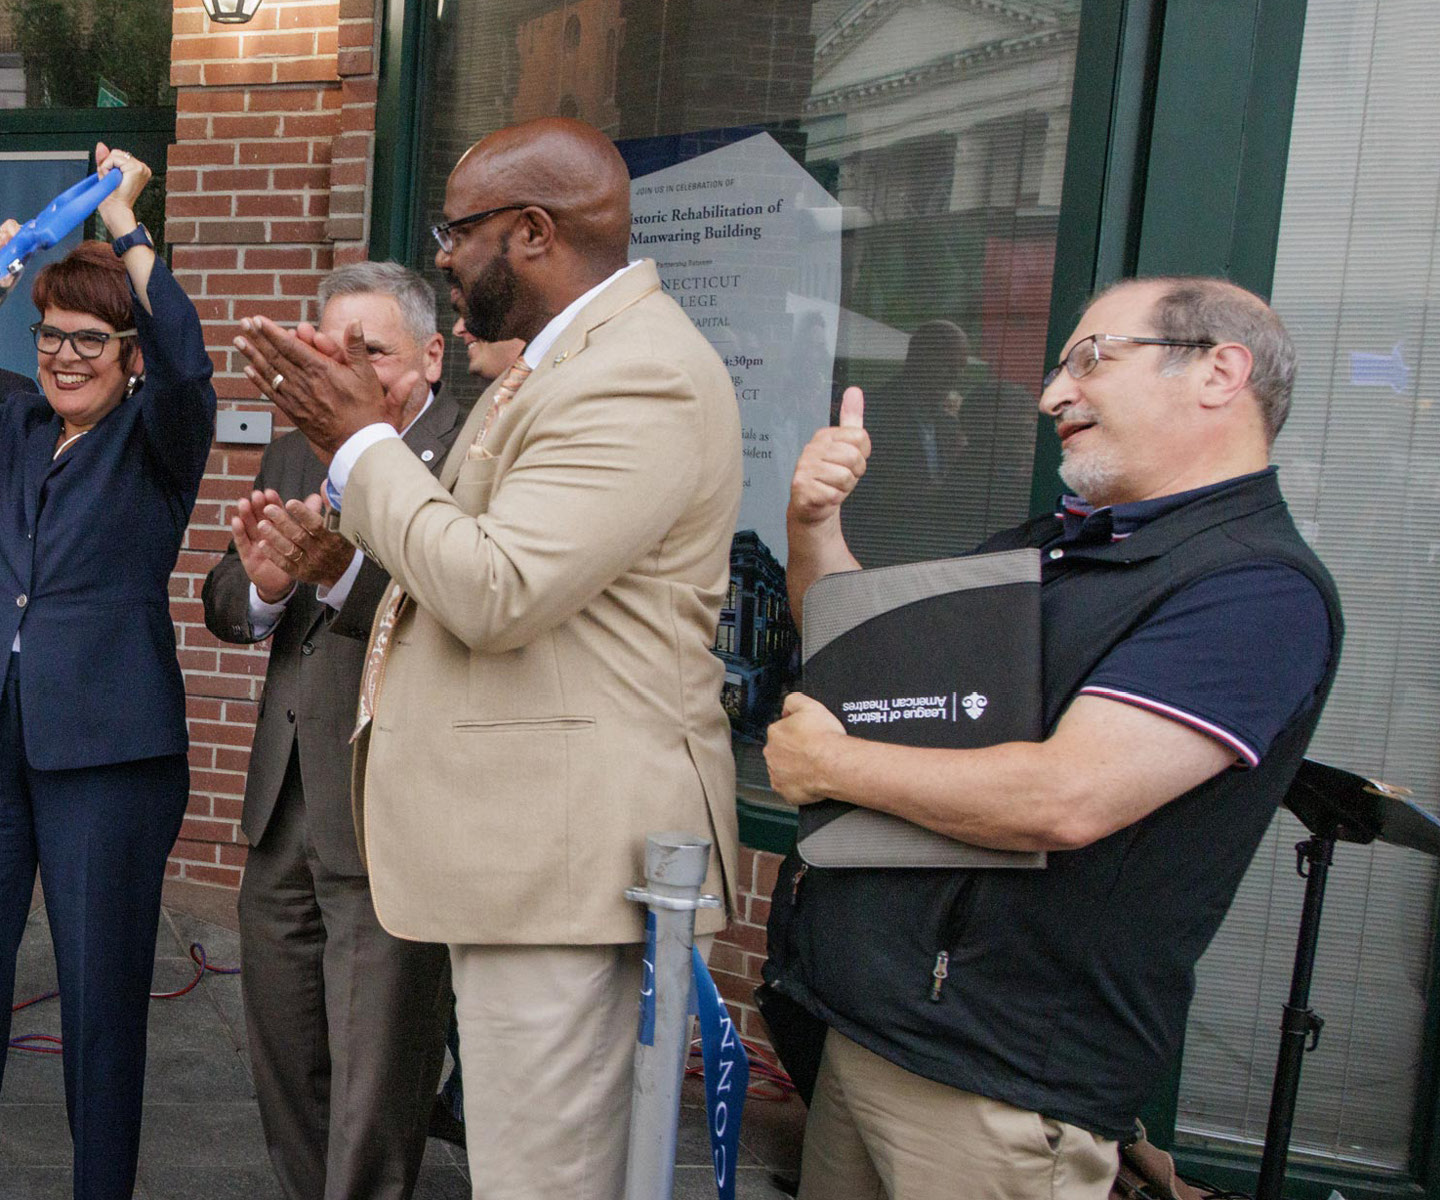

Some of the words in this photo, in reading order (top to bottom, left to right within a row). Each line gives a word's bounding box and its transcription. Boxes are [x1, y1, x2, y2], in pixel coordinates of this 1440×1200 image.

[635, 187, 653, 196] JOIN
[654, 185, 665, 194] US
[666, 184, 674, 192] IN
[675, 180, 723, 192] CELEBRATION
[724, 178, 735, 187] OF
[672, 203, 763, 222] Rehabilitation
[767, 199, 784, 214] of
[630, 229, 701, 245] Manwaring
[705, 224, 761, 241] Building
[742, 389, 760, 401] CT
[842, 699, 890, 711] Theatres
[892, 696, 947, 708] American
[847, 711, 887, 725] Historic
[888, 709, 901, 722] of
[903, 707, 947, 720] League
